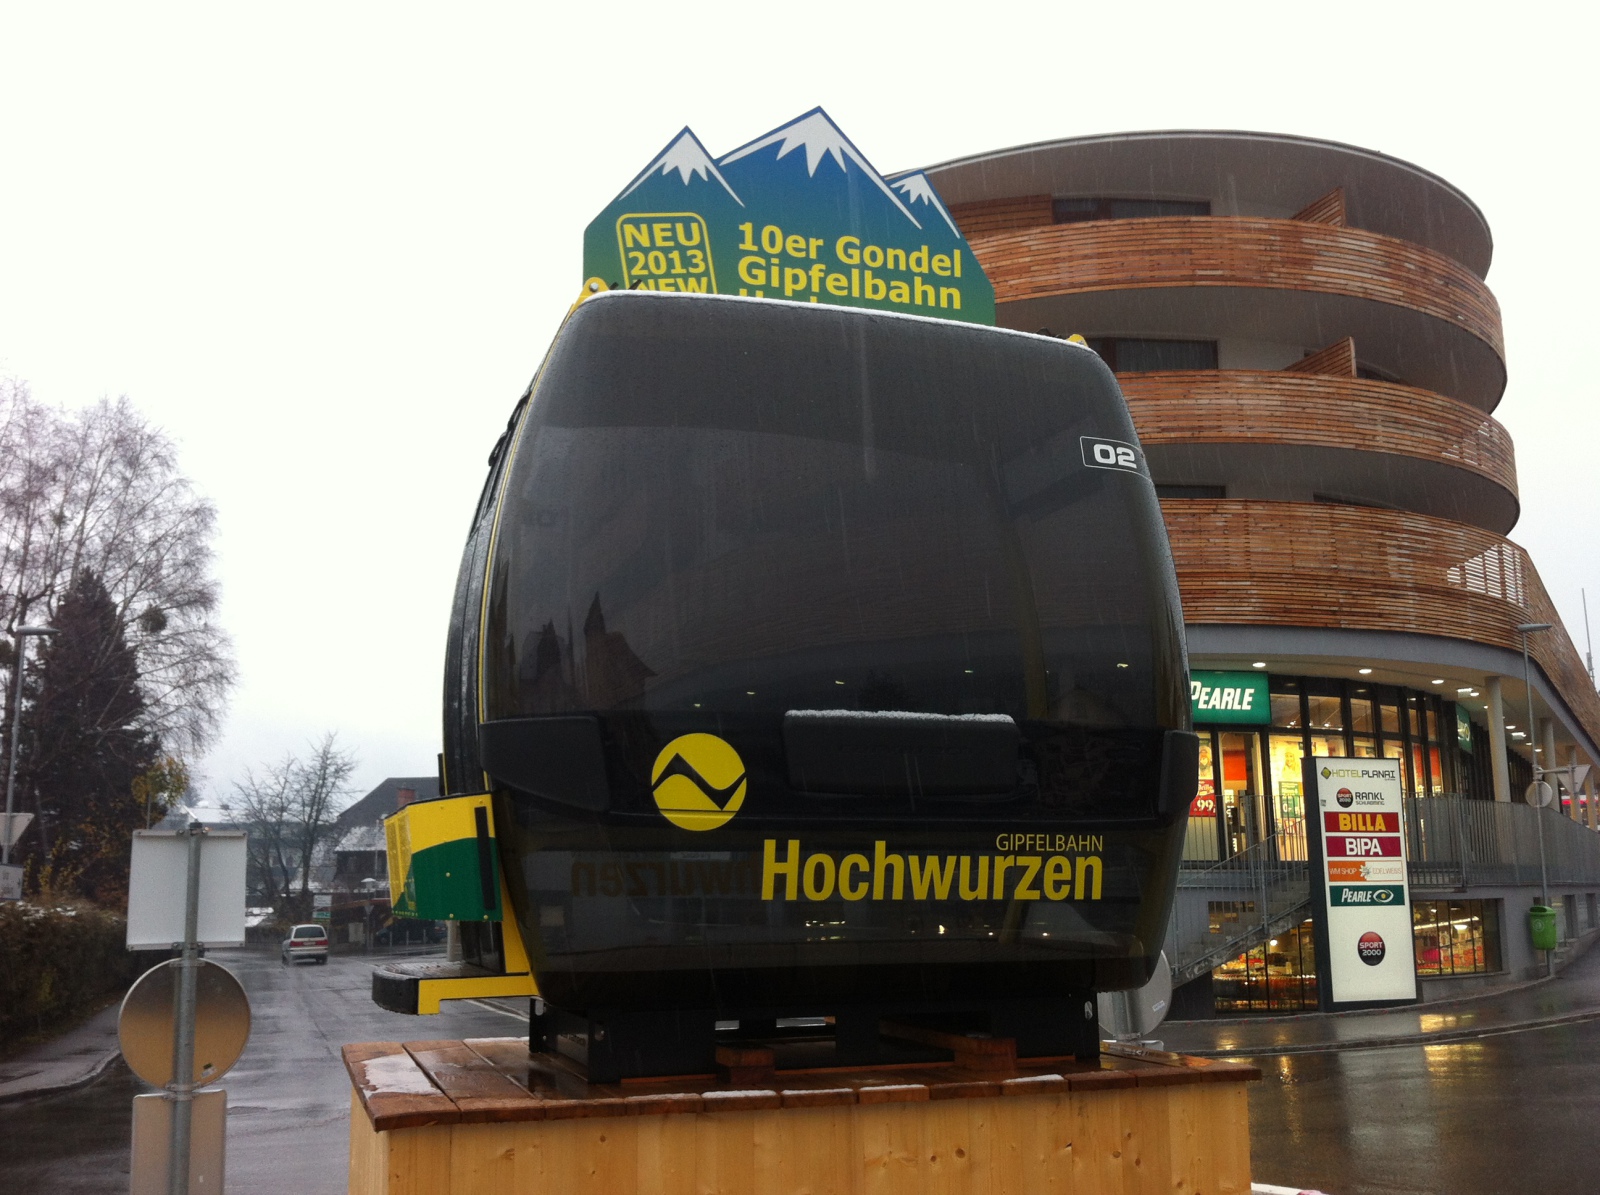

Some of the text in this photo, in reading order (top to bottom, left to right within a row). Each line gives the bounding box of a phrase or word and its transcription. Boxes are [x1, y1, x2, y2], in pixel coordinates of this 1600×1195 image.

[623, 222, 701, 248] NEU
[738, 222, 962, 278] 10er Gondel
[628, 249, 706, 276] 2013
[738, 255, 962, 310] Gipfelbahn
[1093, 443, 1138, 469] 02
[1355, 791, 1385, 801] RANKL
[1338, 813, 1387, 832] BILLA
[996, 833, 1103, 853] GIPFELBAHN
[1345, 838, 1383, 856] BIPA
[761, 838, 1103, 902] Hochwurzen
[1341, 888, 1373, 903] PEARLE
[1359, 941, 1383, 949] SPORT
